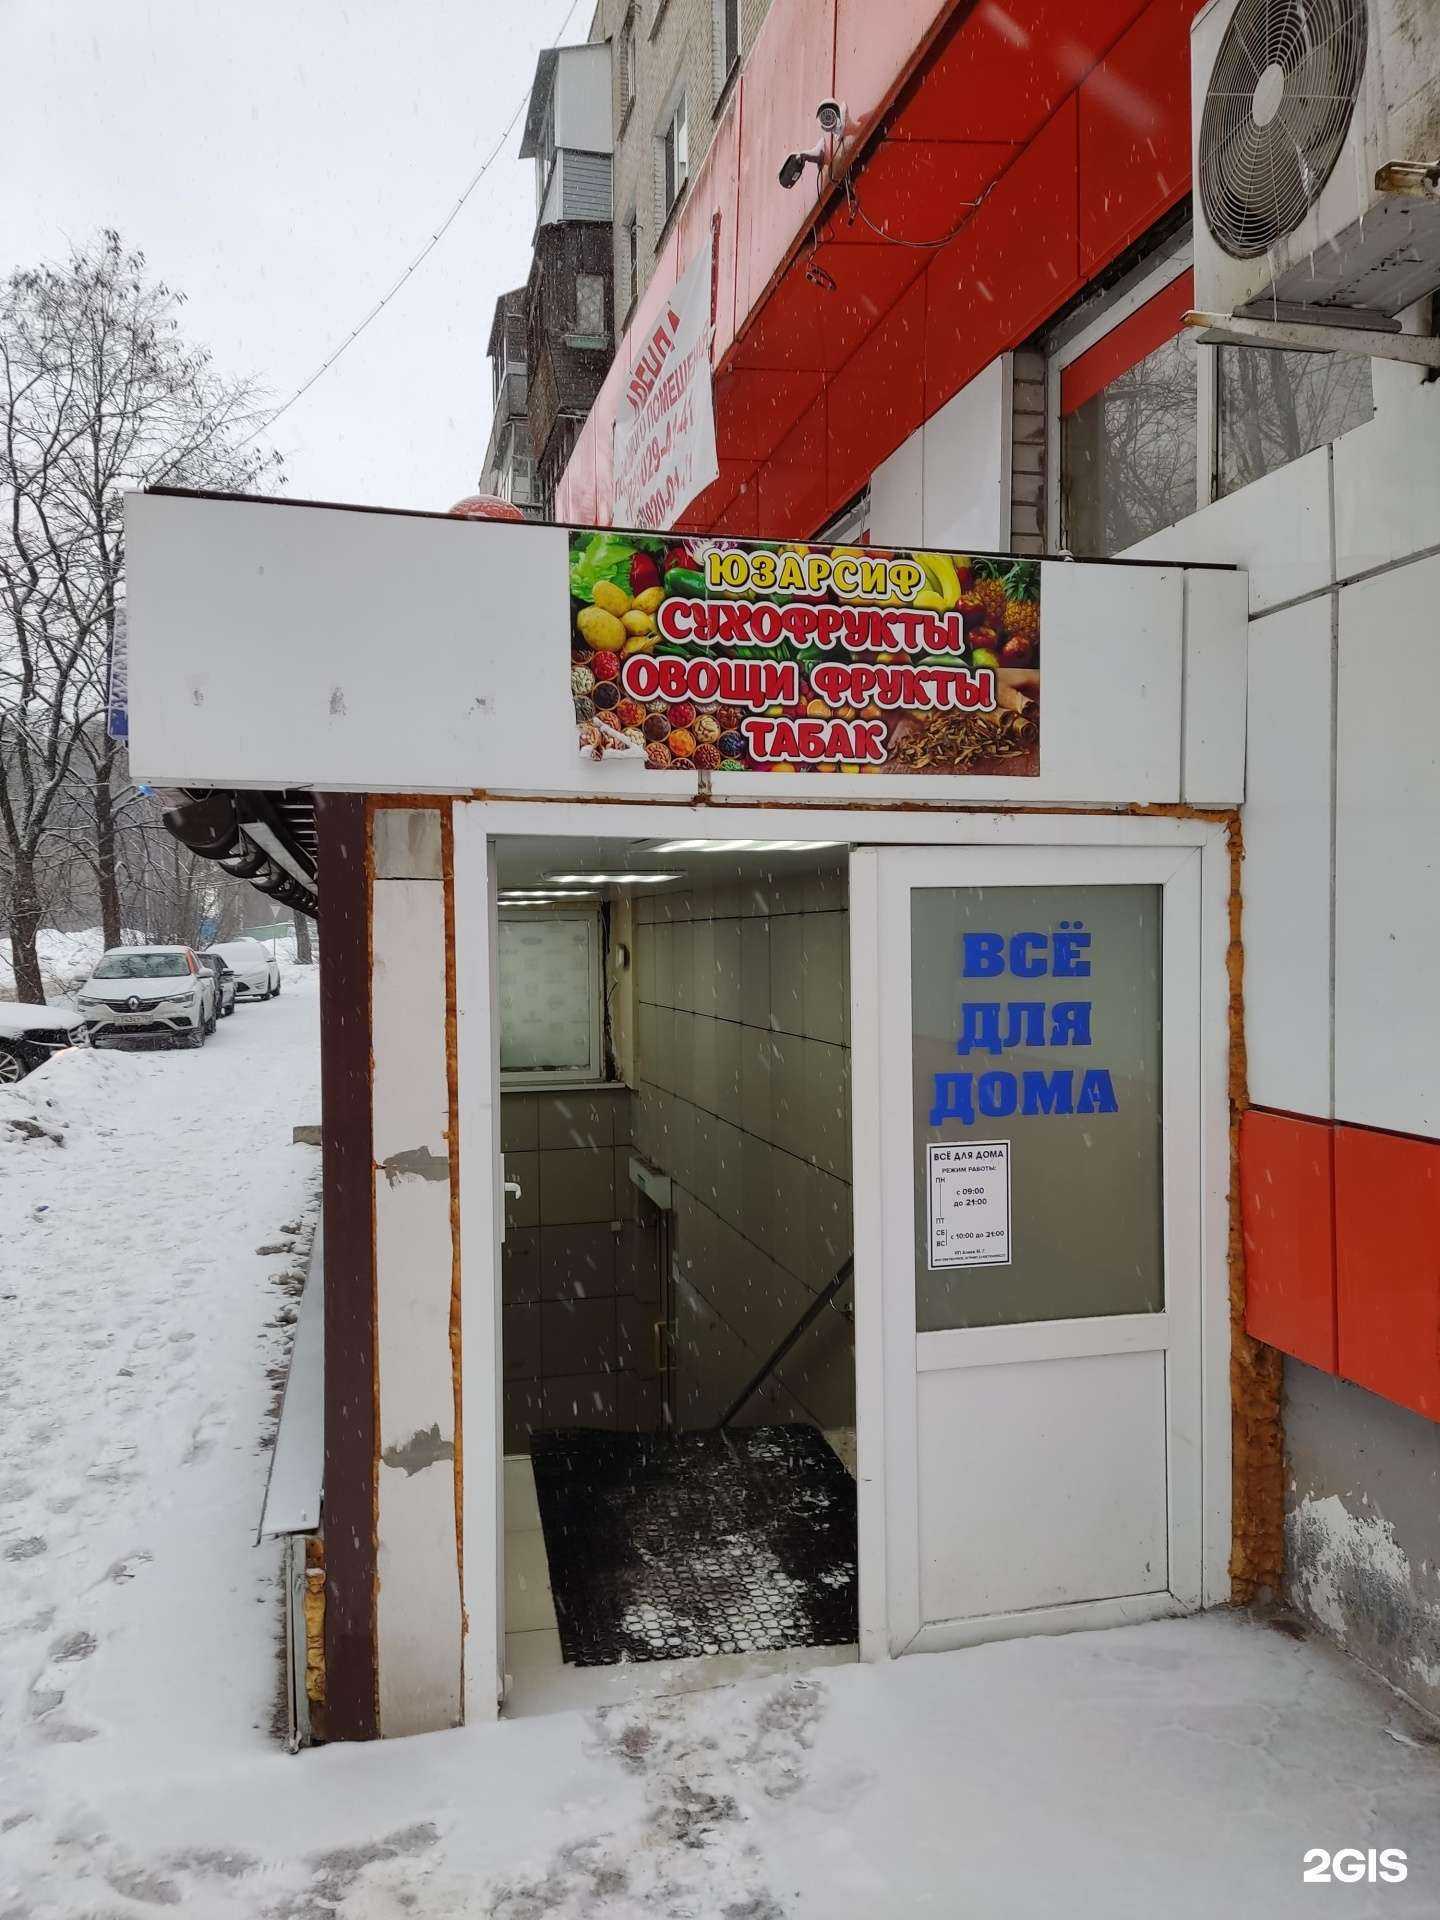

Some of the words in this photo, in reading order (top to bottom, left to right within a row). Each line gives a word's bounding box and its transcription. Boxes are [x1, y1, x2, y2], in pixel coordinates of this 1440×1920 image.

[709, 552, 922, 596] ЮЗАРСИФ
[661, 603, 962, 652] СУХОФРУКТЫ
[626, 659, 798, 705] ОВОЩИ
[815, 667, 994, 708] ФРУКТЫ
[744, 719, 885, 760] ТАБАК
[961, 920, 1092, 978] ВСЁ
[956, 1001, 1092, 1056] ДЛЯ
[929, 1069, 1119, 1127] ДОМА
[933, 1151, 951, 1161] ВСЁ
[953, 1151, 973, 1161] ДЛЯ
[975, 1150, 1004, 1160] ДОМА
[941, 1166, 967, 1174] РЕЖИМ
[953, 1200, 964, 1208] до
[966, 1198, 988, 1207] 21:00
[962, 1187, 985, 1196] 09:00
[955, 1232, 974, 1240] 10:00
